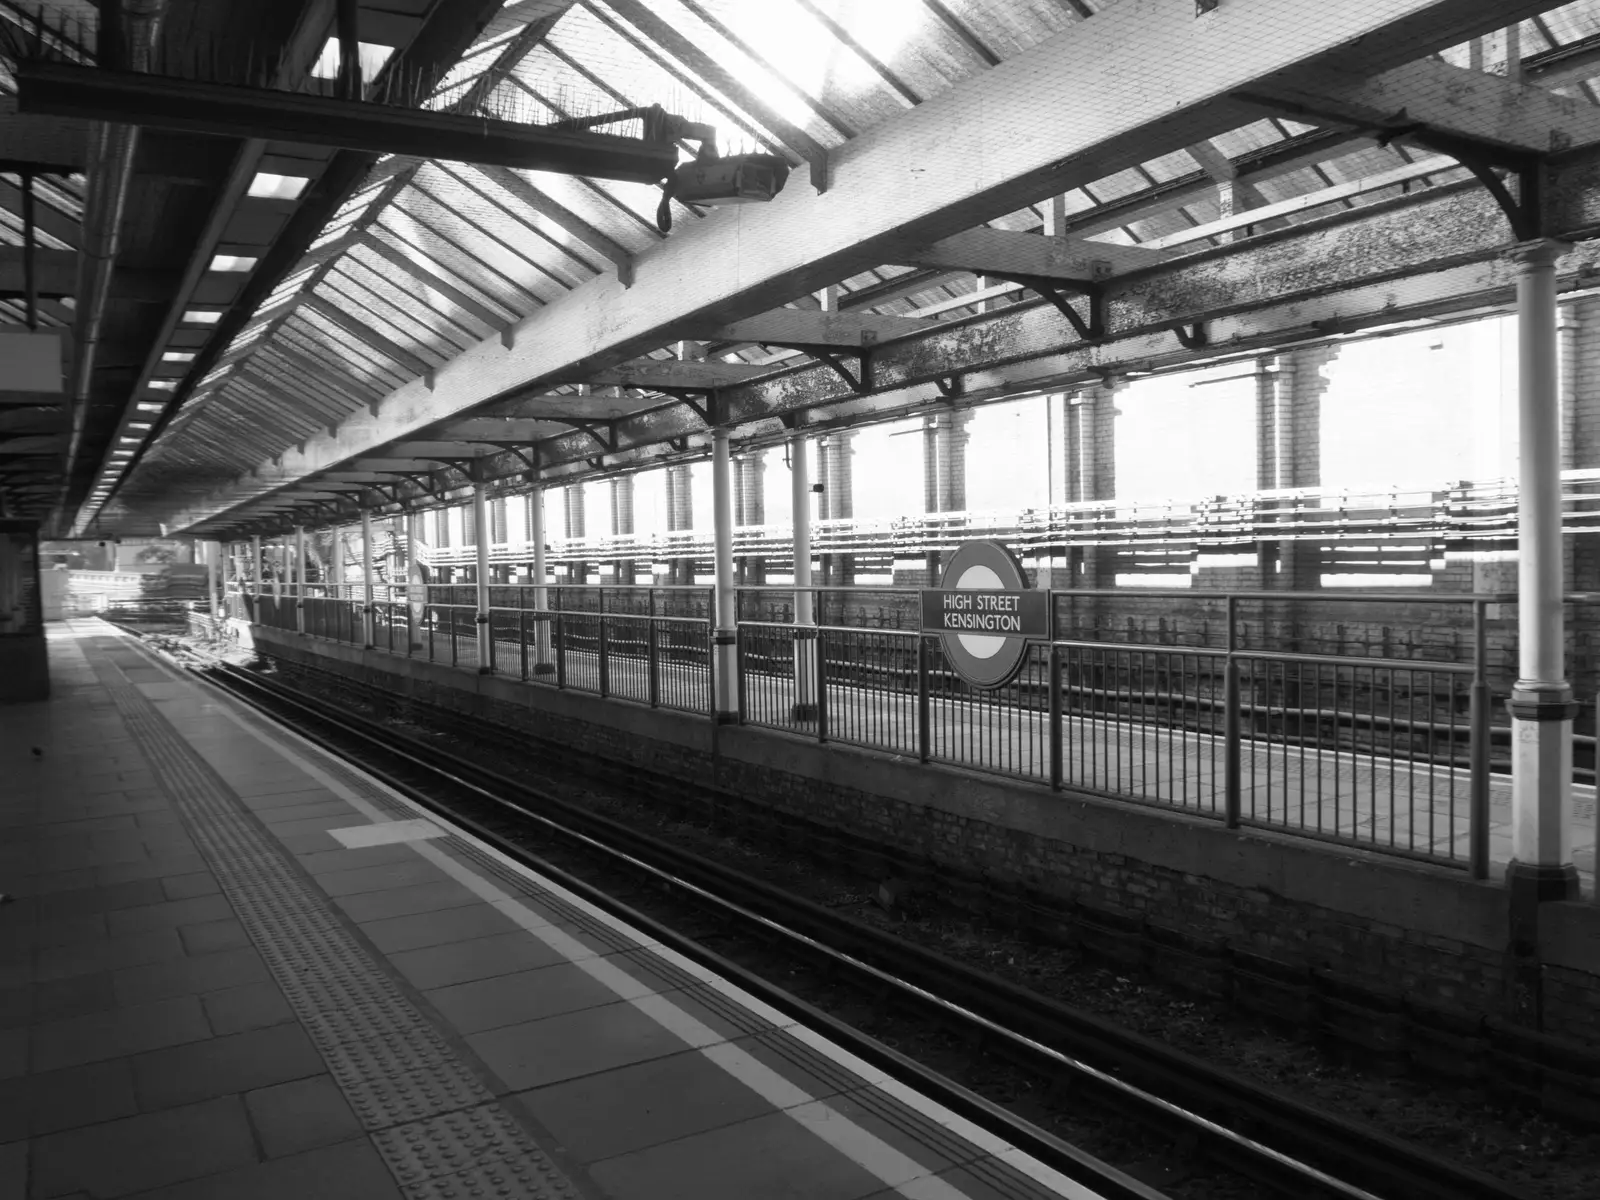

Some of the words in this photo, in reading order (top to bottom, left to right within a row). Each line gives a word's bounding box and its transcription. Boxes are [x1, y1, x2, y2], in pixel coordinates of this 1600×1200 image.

[943, 594, 972, 610] HIGH
[977, 595, 1020, 611] STREET
[944, 612, 1020, 631] KENSINGTON
